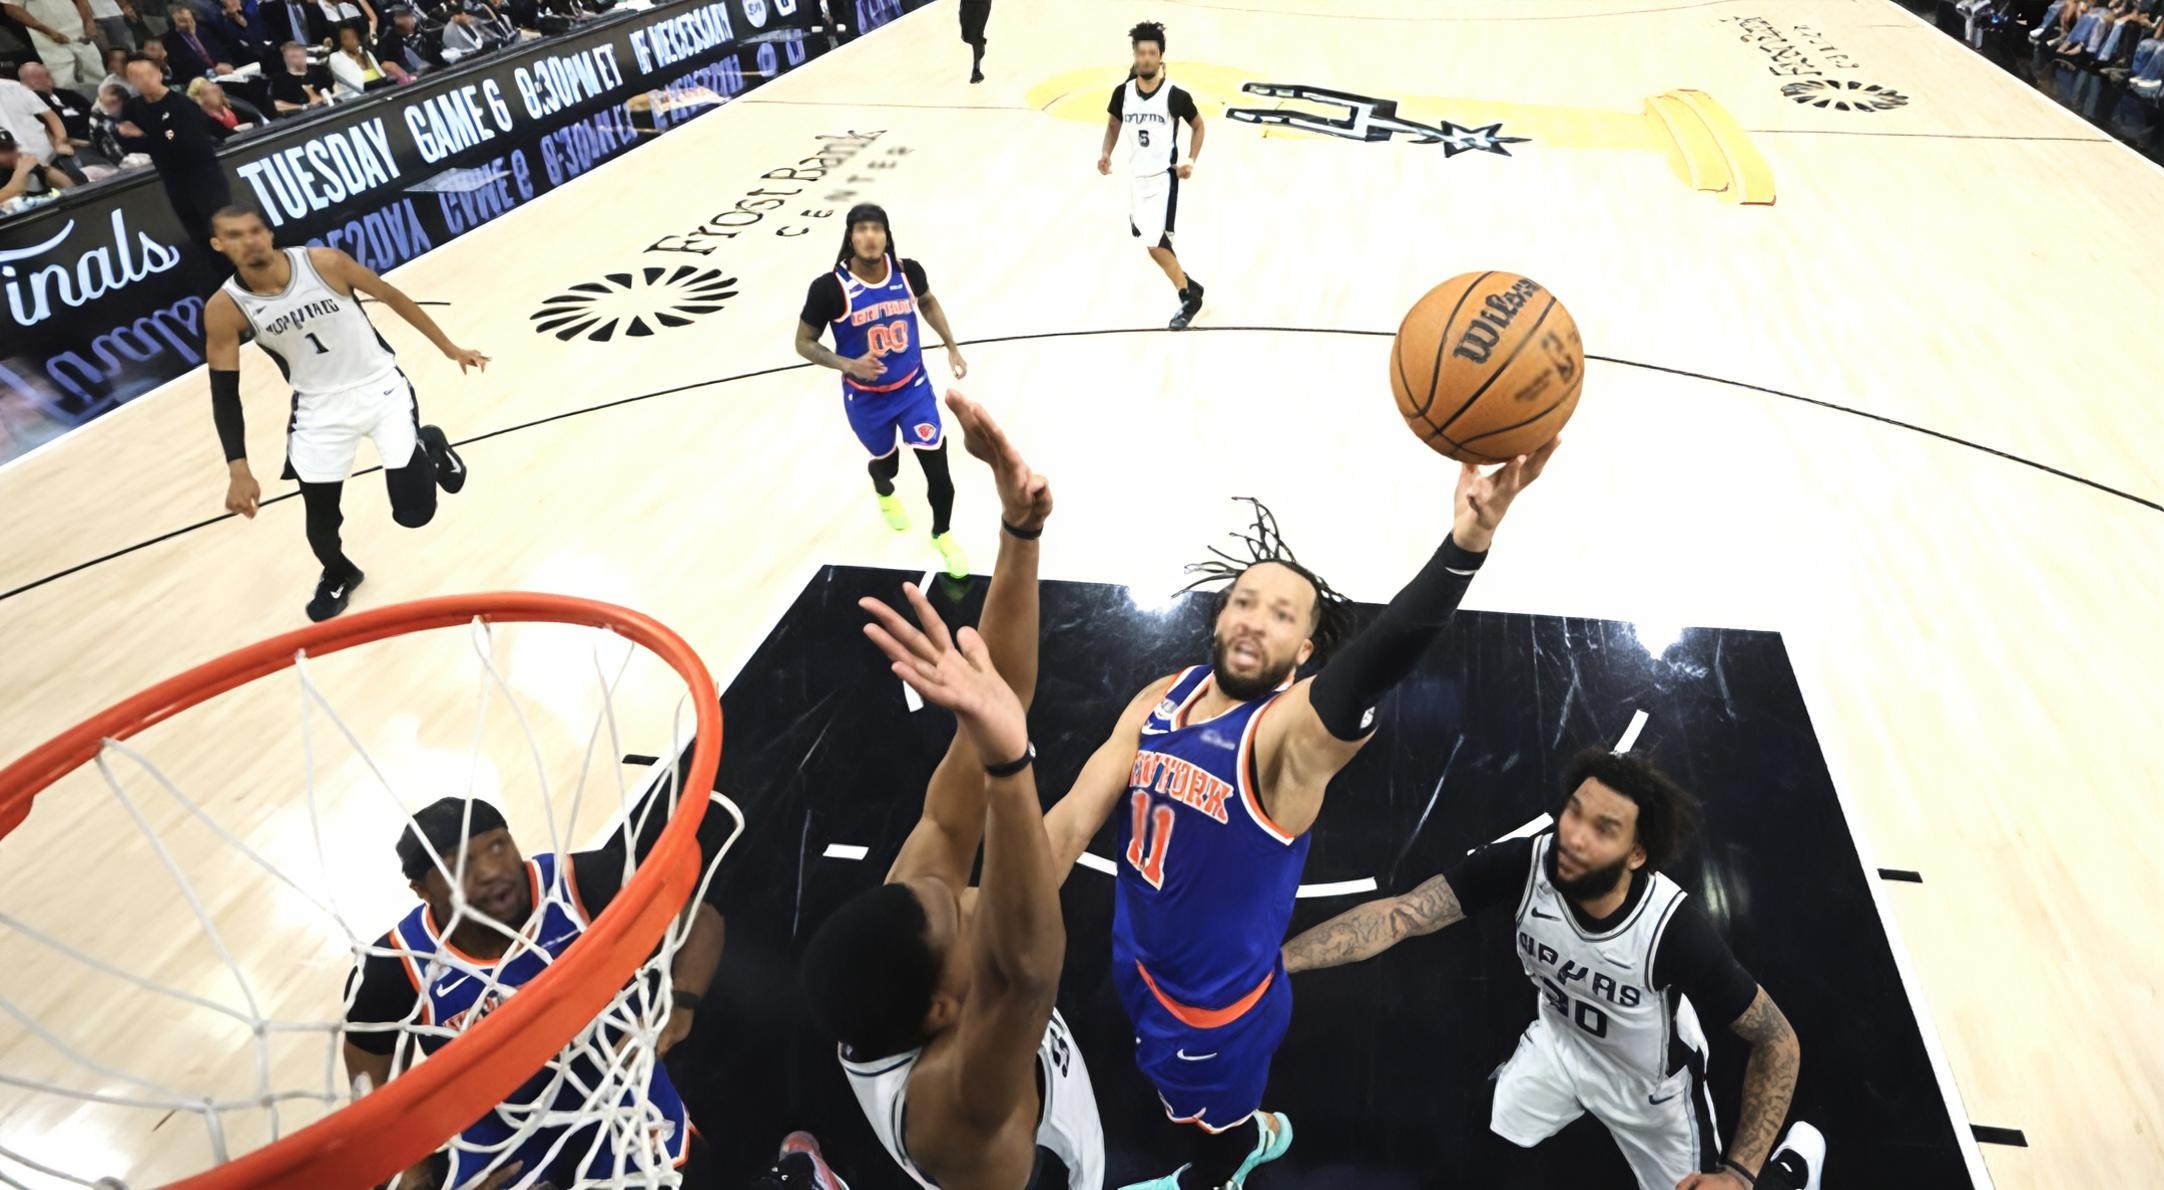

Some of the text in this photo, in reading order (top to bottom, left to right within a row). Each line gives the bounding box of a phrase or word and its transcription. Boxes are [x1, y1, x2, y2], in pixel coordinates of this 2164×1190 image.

[236, 117, 401, 227] TUESDAY
[404, 85, 496, 164] GAME
[482, 78, 514, 133] 6
[1126, 788, 1176, 892] 11
